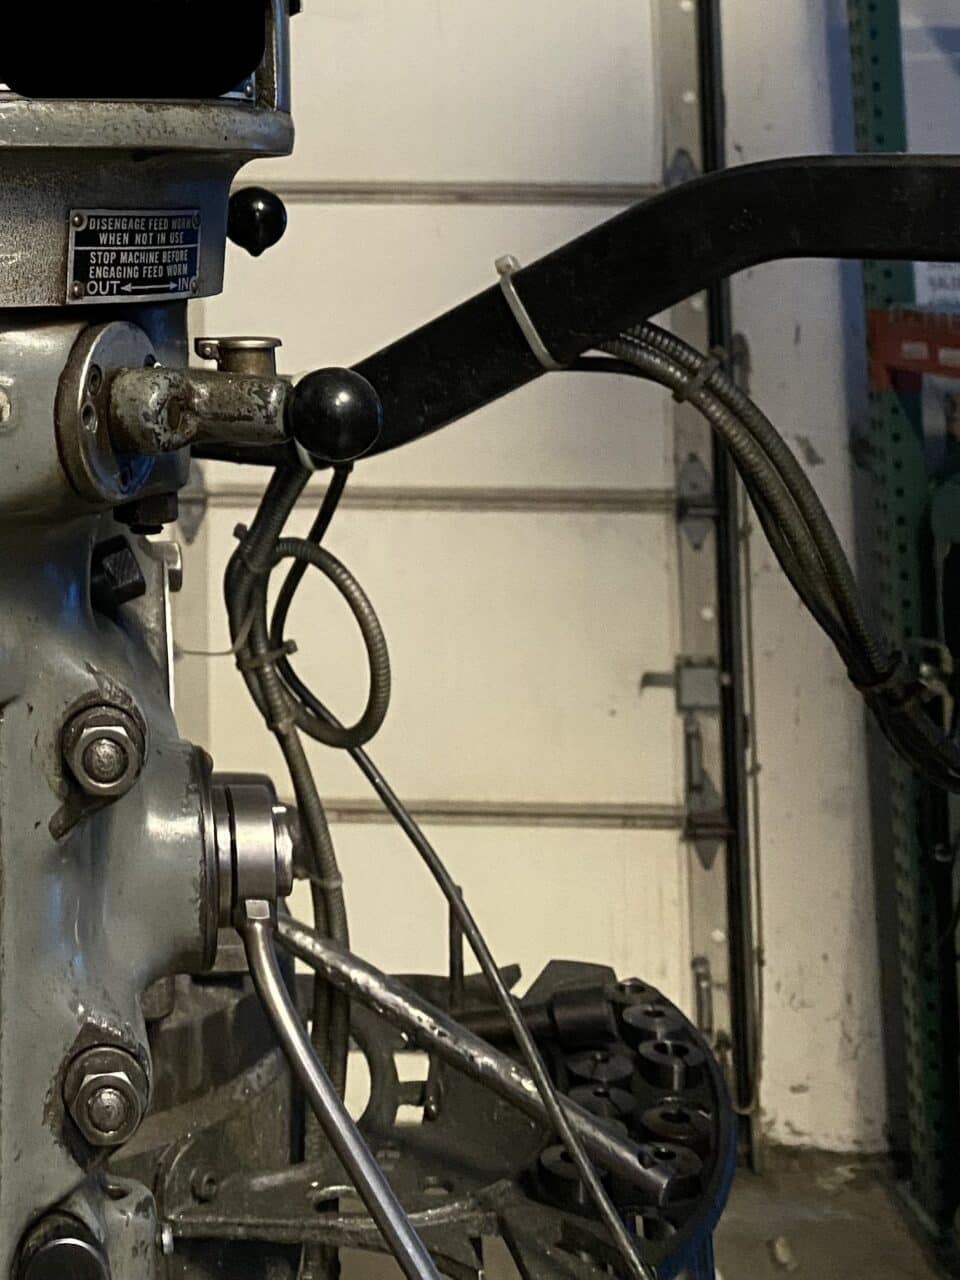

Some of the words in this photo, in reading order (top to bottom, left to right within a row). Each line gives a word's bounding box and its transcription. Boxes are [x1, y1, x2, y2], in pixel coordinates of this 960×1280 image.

[89, 217, 145, 231] DISENGAGE
[148, 217, 168, 230] FEED
[171, 216, 192, 229] WORM
[99, 232, 129, 245] WHEN
[134, 232, 153, 245] NOT
[157, 232, 166, 245] IN
[169, 231, 184, 244] USE
[89, 251, 116, 264] STOP
[119, 250, 159, 264] MACHINE
[162, 249, 188, 263] BEFORE
[89, 265, 139, 279] ENGAGING
[142, 265, 163, 278] FEED
[166, 263, 188, 276] WORM
[86, 280, 120, 295] OUT
[178, 277, 189, 292] IN
